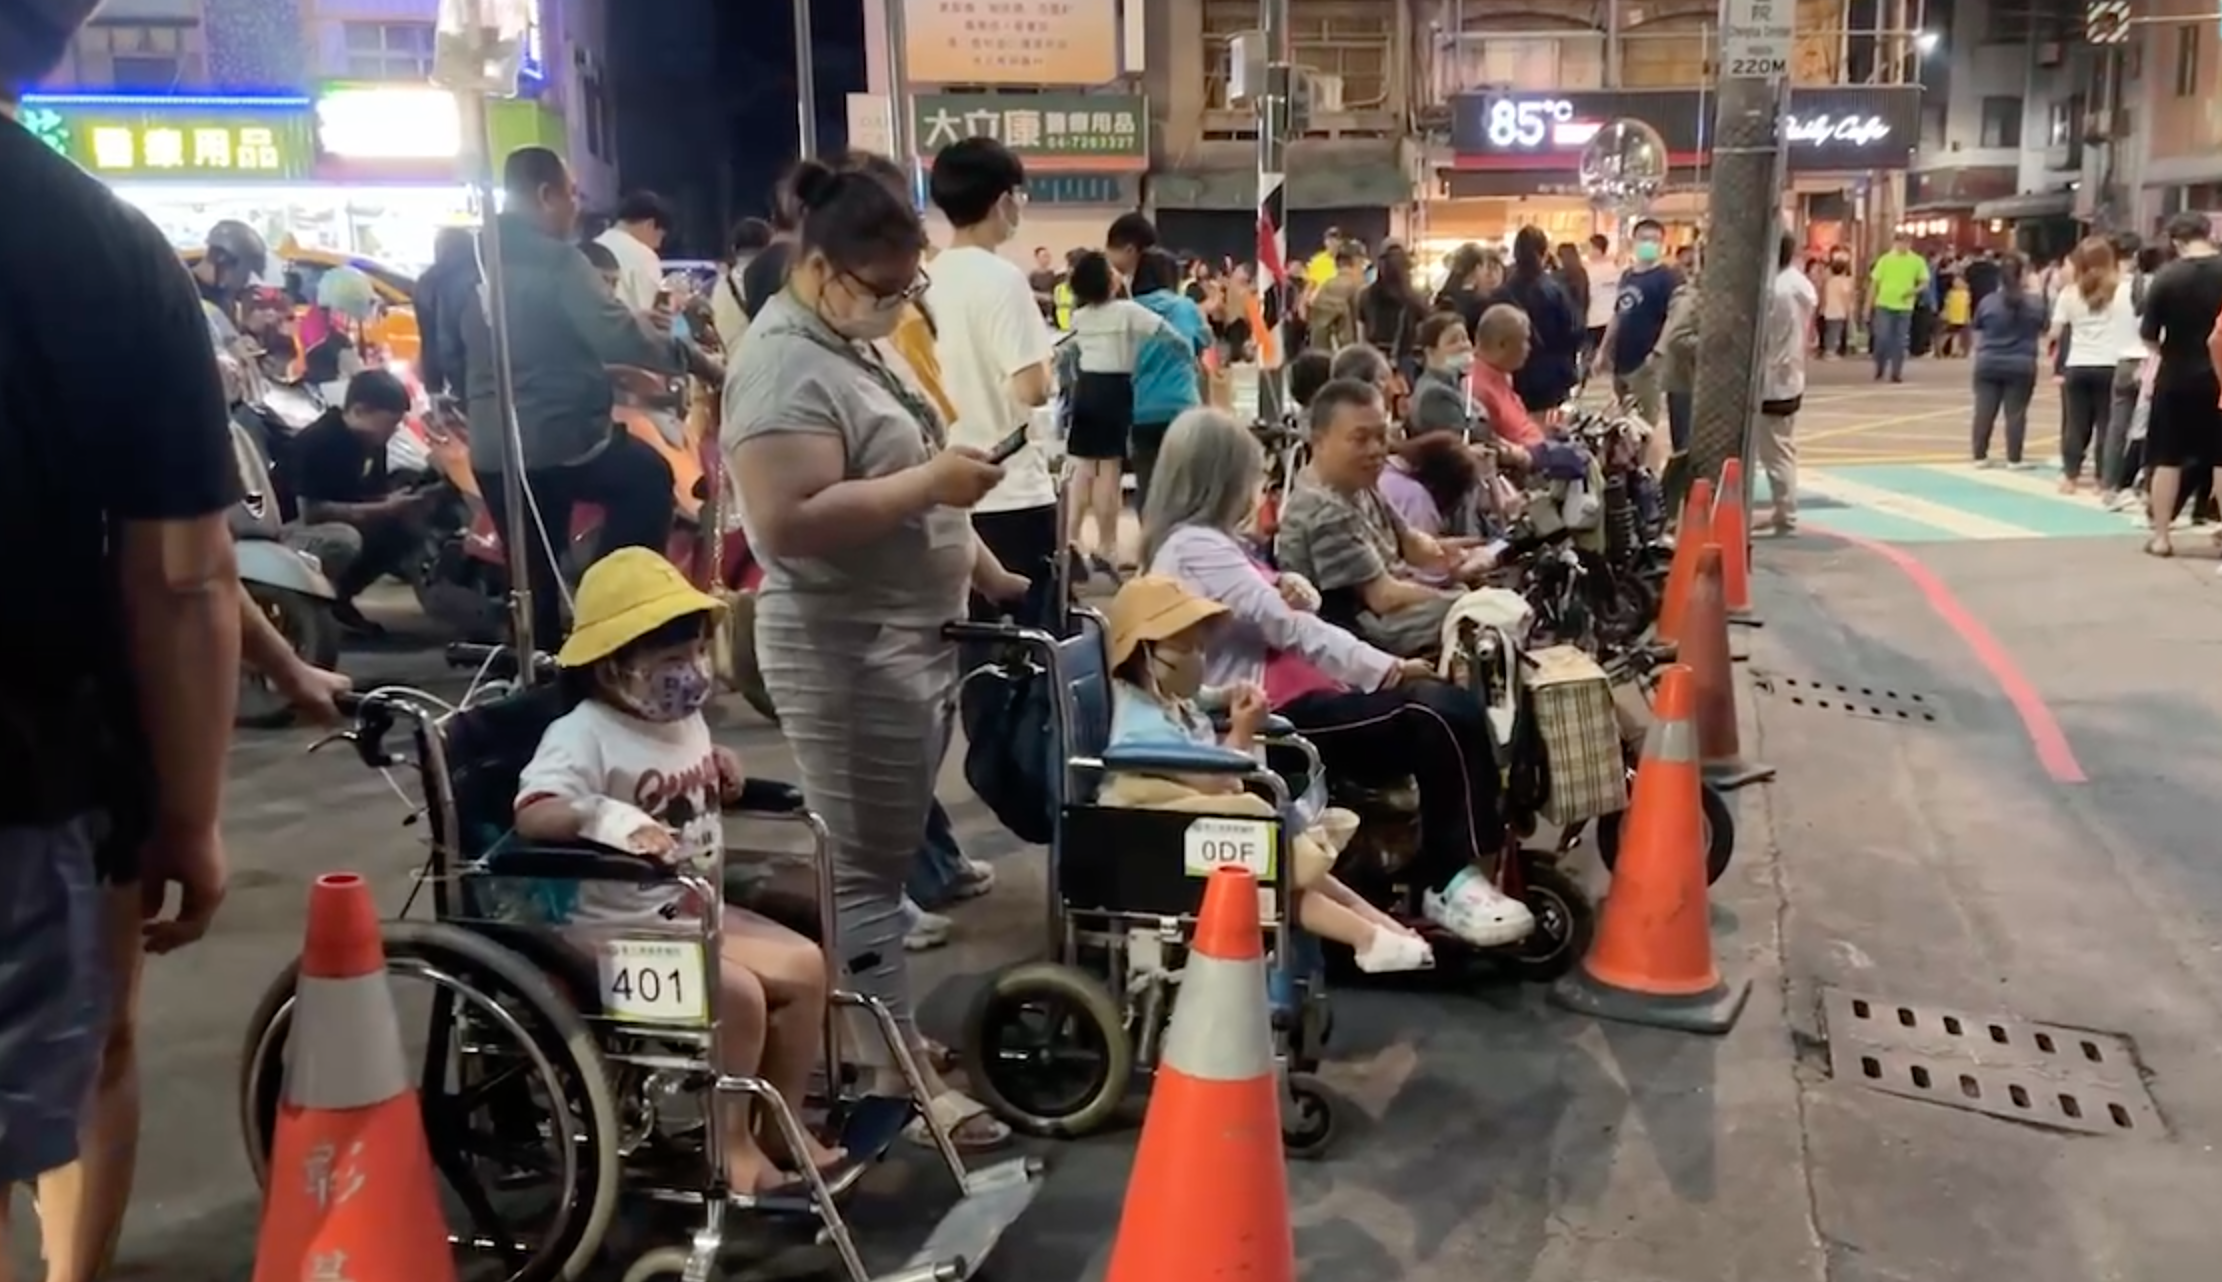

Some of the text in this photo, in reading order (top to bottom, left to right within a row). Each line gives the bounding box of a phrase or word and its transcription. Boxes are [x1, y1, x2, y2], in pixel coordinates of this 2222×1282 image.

[1731, 59, 1786, 75] 220M
[923, 107, 1042, 147] 大立康
[611, 967, 683, 1005] 401
